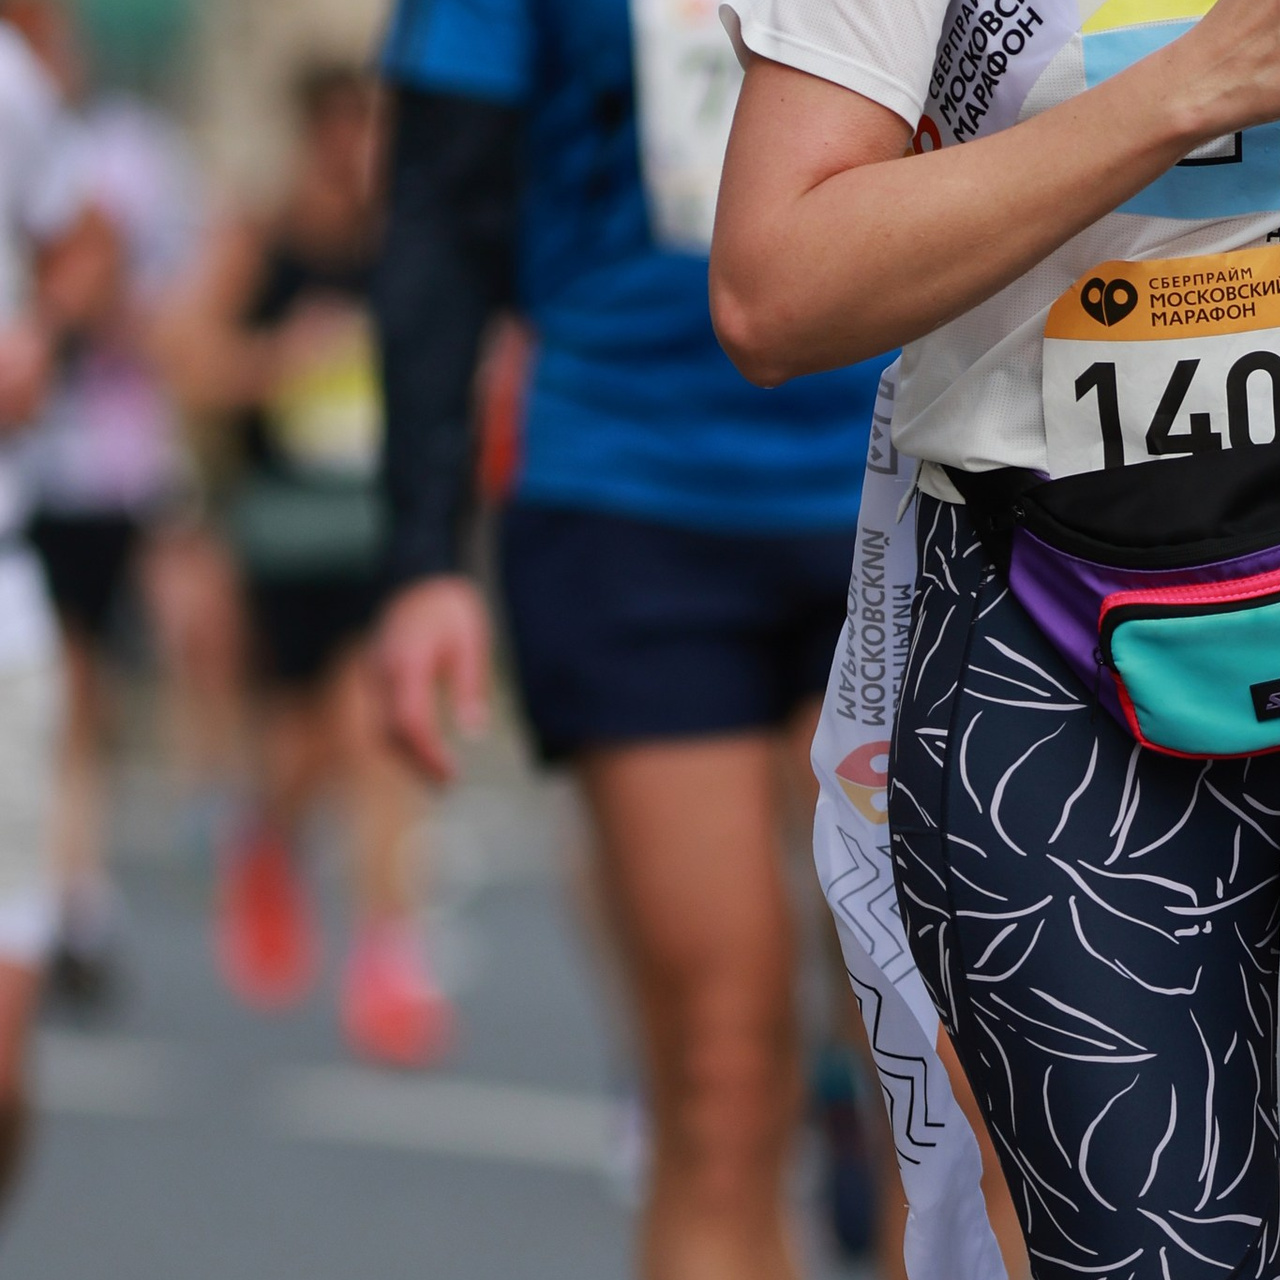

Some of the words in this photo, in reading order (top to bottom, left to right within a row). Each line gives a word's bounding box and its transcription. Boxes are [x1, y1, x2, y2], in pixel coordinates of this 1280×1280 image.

[952, 6, 1044, 145] МАРАФОН
[1149, 267, 1253, 290] СБЕРПРАЙМ
[1151, 302, 1257, 327] МАРАФОН
